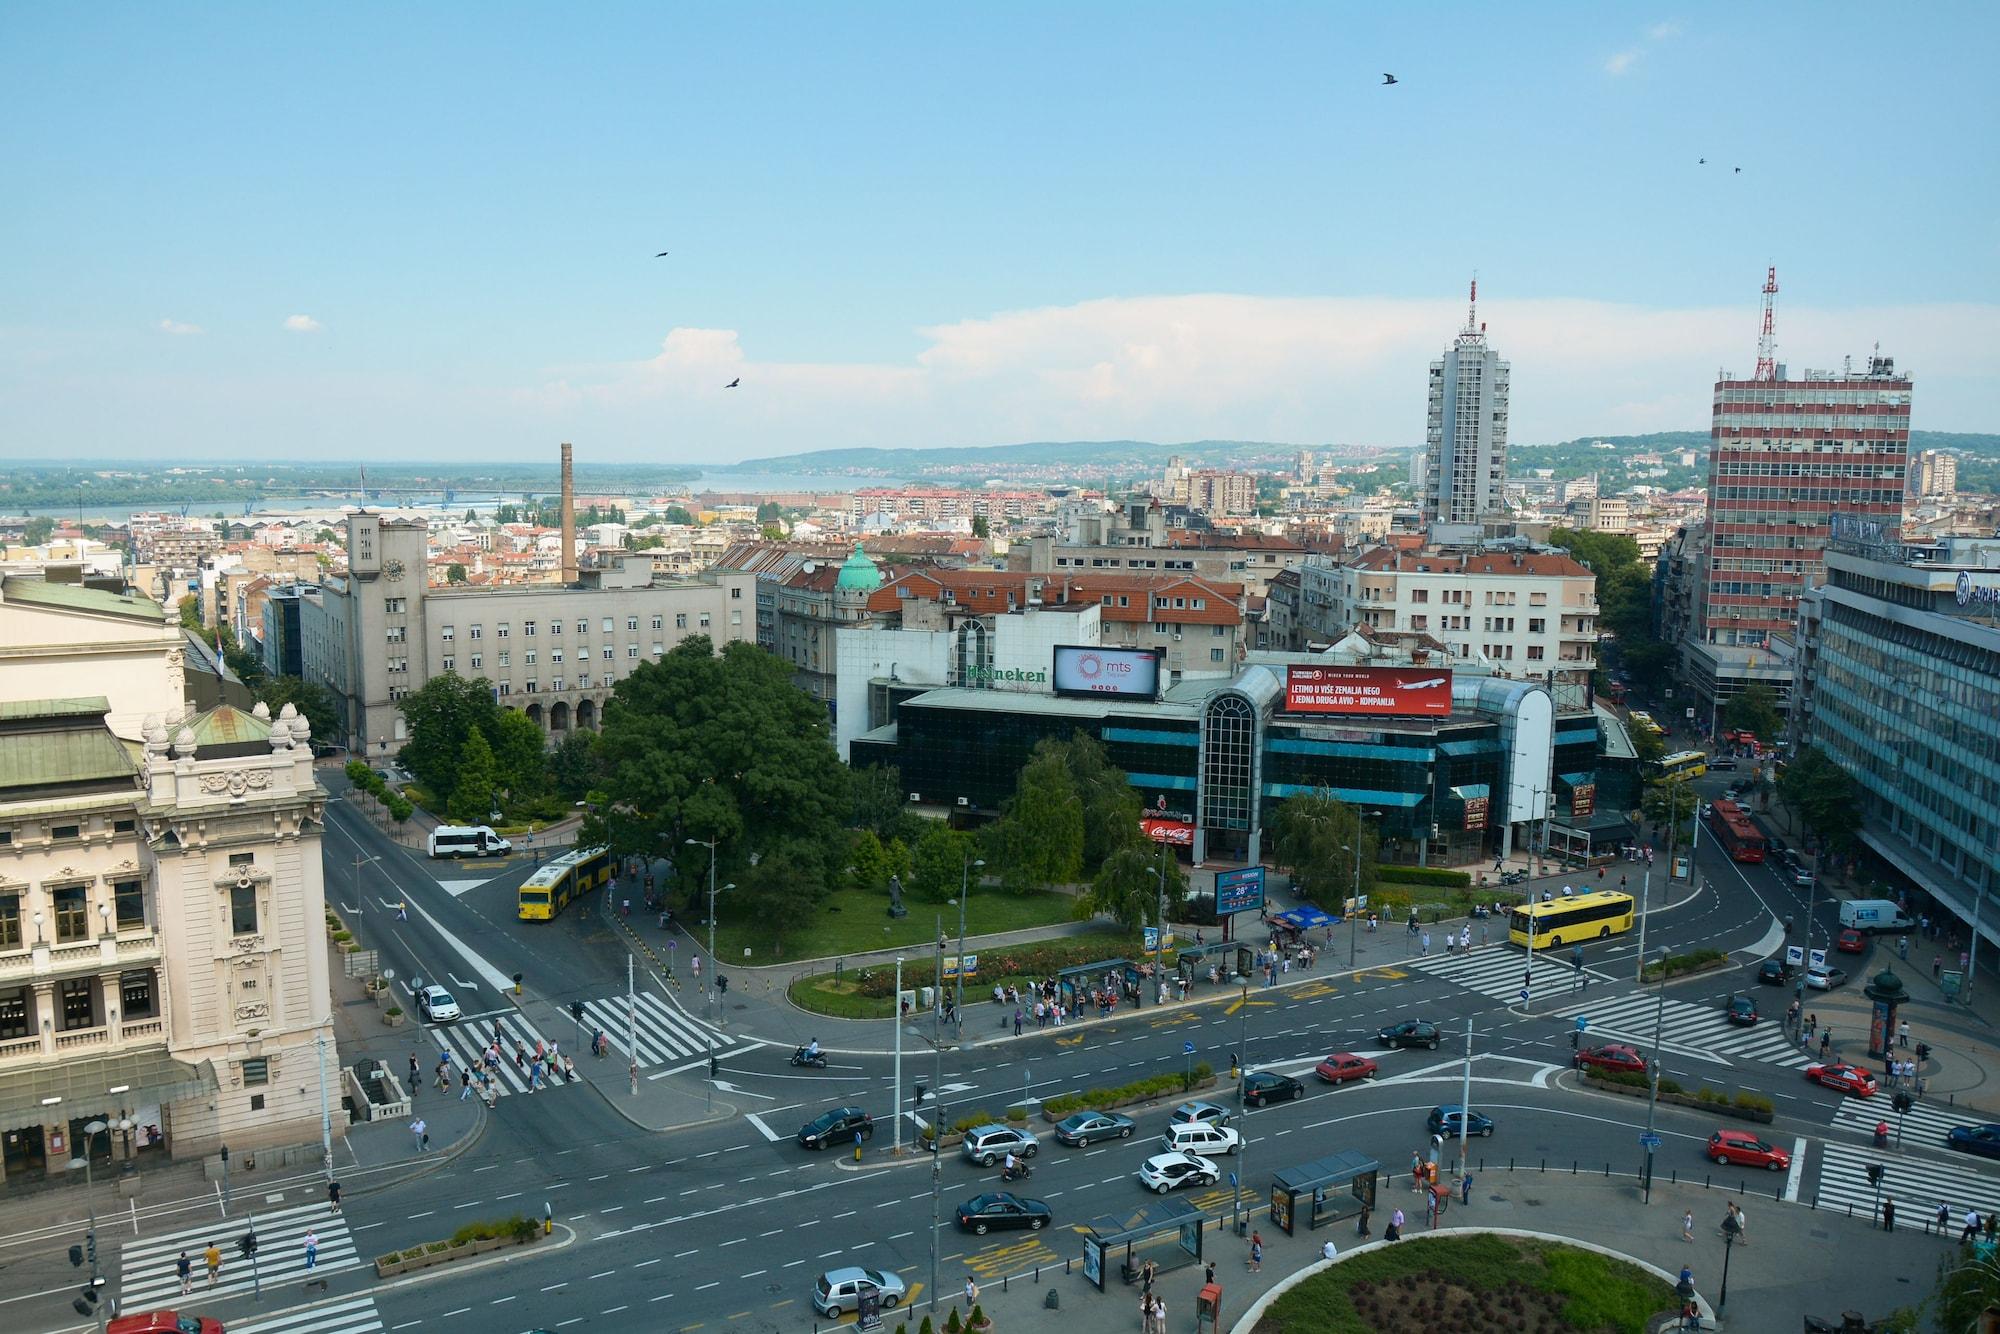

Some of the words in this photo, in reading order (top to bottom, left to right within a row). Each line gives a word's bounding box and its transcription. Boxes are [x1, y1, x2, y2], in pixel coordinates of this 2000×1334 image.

[1106, 661, 1132, 673] mts
[1292, 684, 1313, 694] LETIMO
[1314, 685, 1320, 694] U
[1320, 683, 1334, 695] VIŠE
[1334, 685, 1362, 695] ZEMALJA
[1363, 686, 1380, 695] NEGO
[1295, 695, 1315, 705] JEDNA
[1315, 696, 1338, 705] DRUGA
[1338, 697, 1354, 706] AVIO
[1359, 697, 1395, 707] KOMPANIJA
